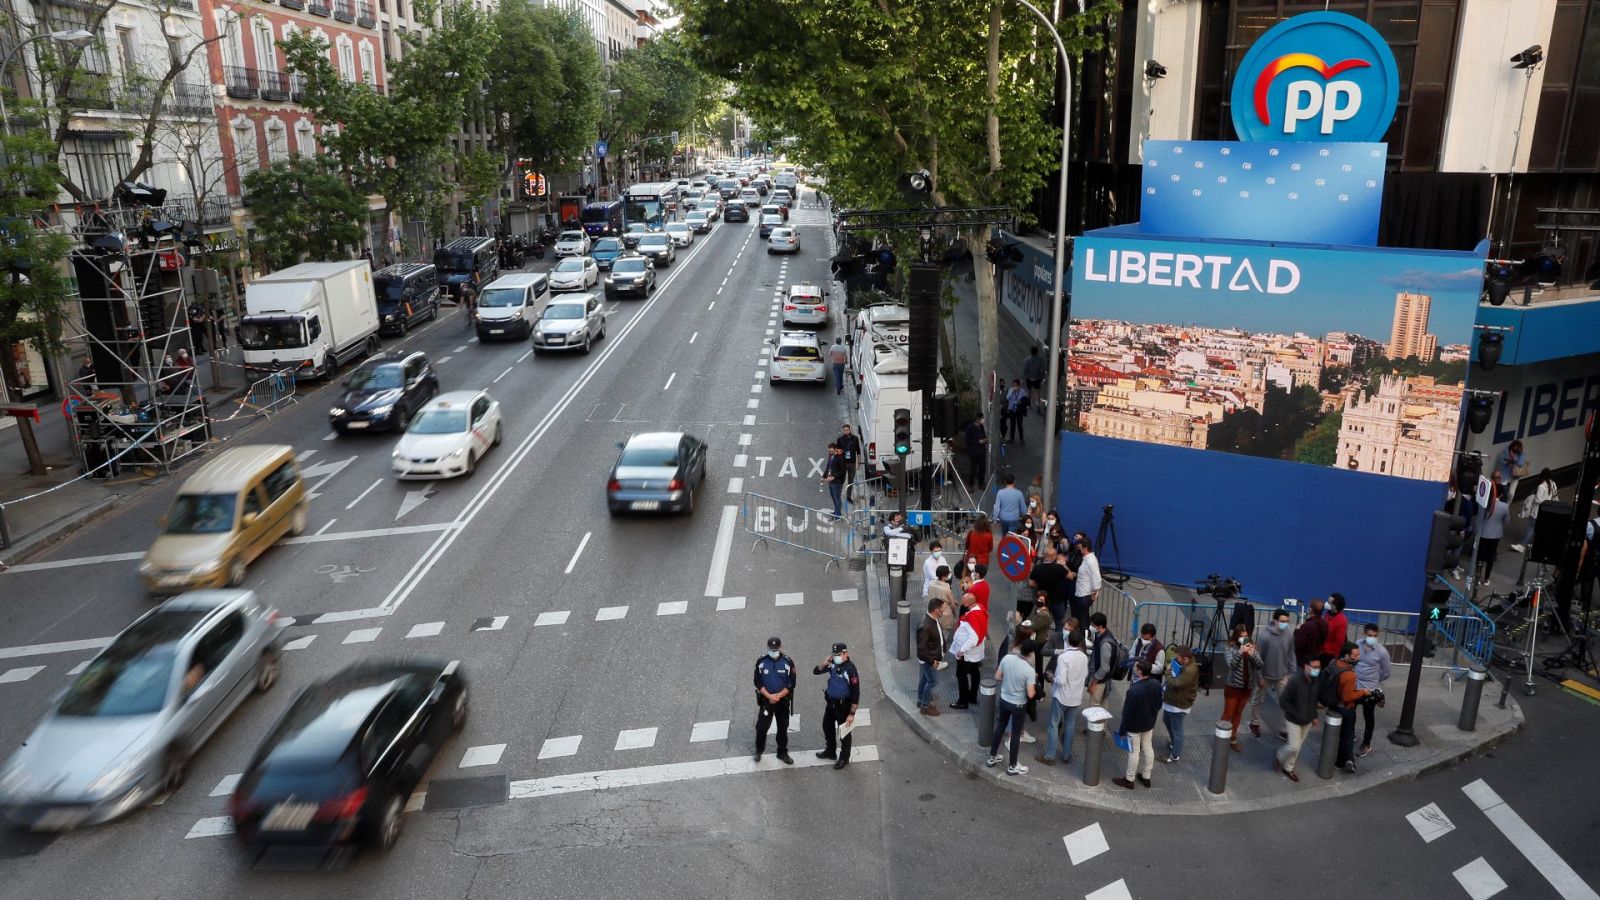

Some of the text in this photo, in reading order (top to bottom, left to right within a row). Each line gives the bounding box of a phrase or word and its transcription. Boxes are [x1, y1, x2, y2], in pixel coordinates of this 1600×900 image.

[1085, 248, 1301, 294] LIBERTAD
[1493, 375, 1600, 445] LIBER
[754, 506, 834, 534] BUS
